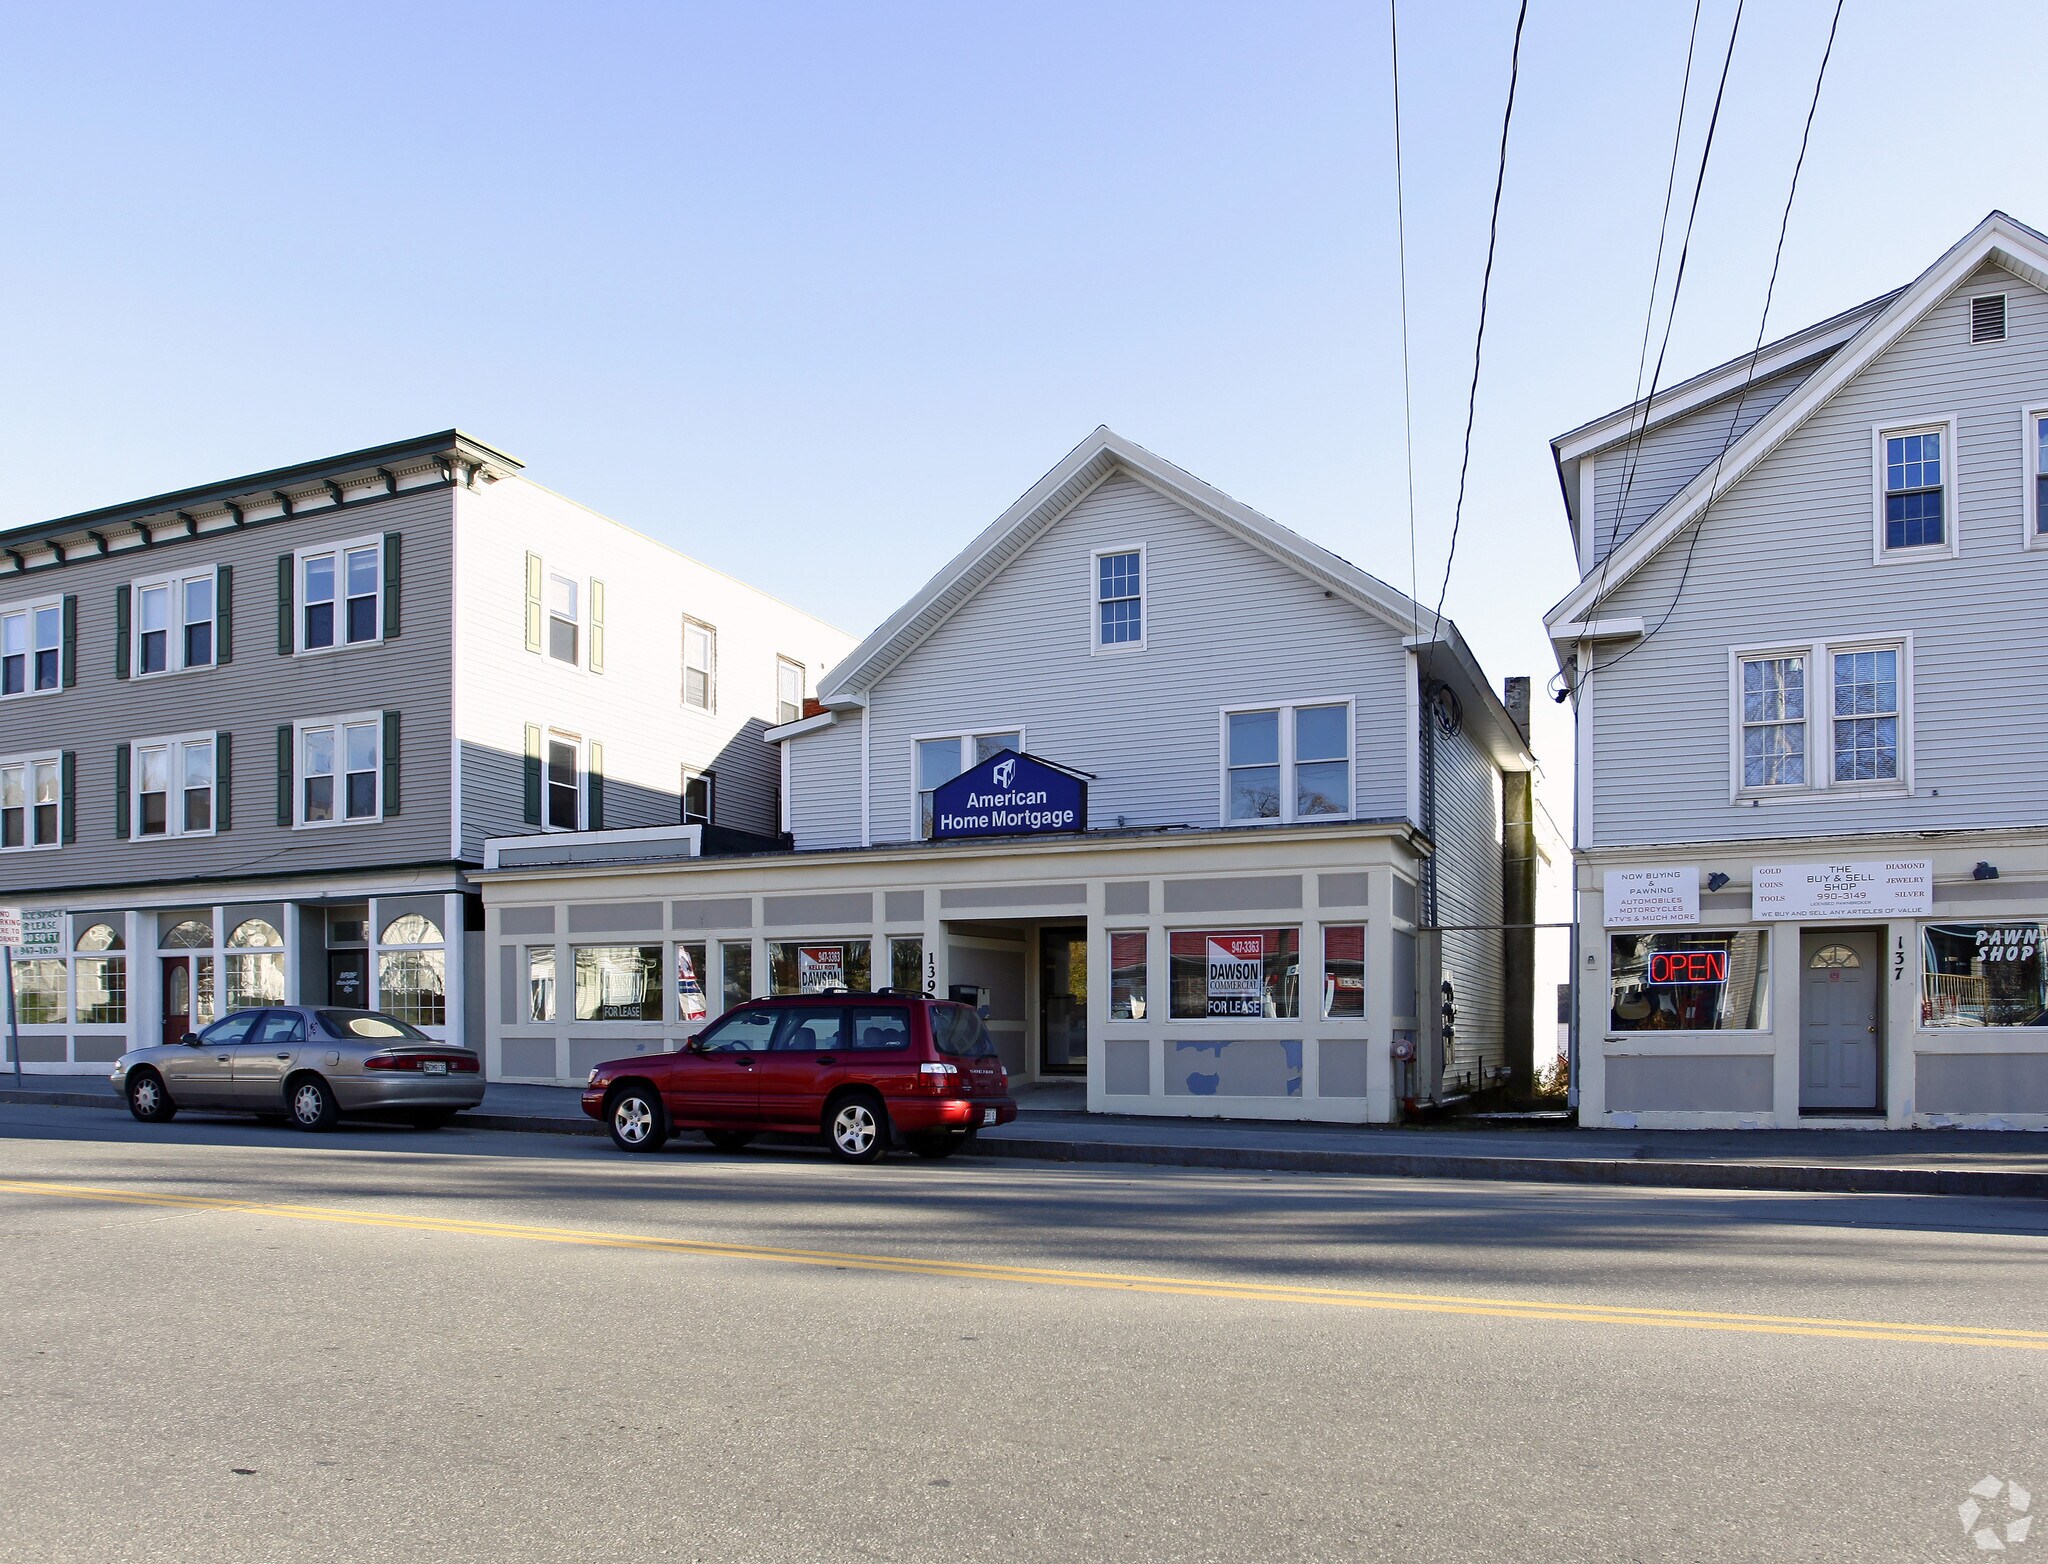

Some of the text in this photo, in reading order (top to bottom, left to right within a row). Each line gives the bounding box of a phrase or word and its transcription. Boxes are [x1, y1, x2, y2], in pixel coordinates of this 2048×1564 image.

[967, 790, 1047, 808] American
[941, 809, 1073, 830] Home Mortgage
[1646, 871, 1681, 879] BUYING
[1807, 873, 1875, 883] BUY & SELL
[1886, 876, 1925, 884] JEWELRY
[1824, 883, 1857, 891] SHOP
[1817, 892, 1867, 900] 990-3149
[1895, 890, 1925, 898] SILVER
[1621, 897, 1683, 905] AUTOMOBILES
[31, 921, 57, 930] LEASE
[34, 933, 46, 943] SQ
[1976, 930, 2038, 945] PAWN
[1232, 941, 1260, 953] 947-3363
[1895, 936, 1904, 981] 137
[1978, 946, 2034, 962] SHOP
[927, 953, 935, 992] 139
[1210, 963, 1258, 980] DAWSON
[1652, 953, 1725, 981] OPEN
[1210, 980, 1259, 990] COMMERCIAL
[604, 1006, 640, 1017] FOR LEASE
[1208, 1000, 1260, 1014] FOR LEASE
